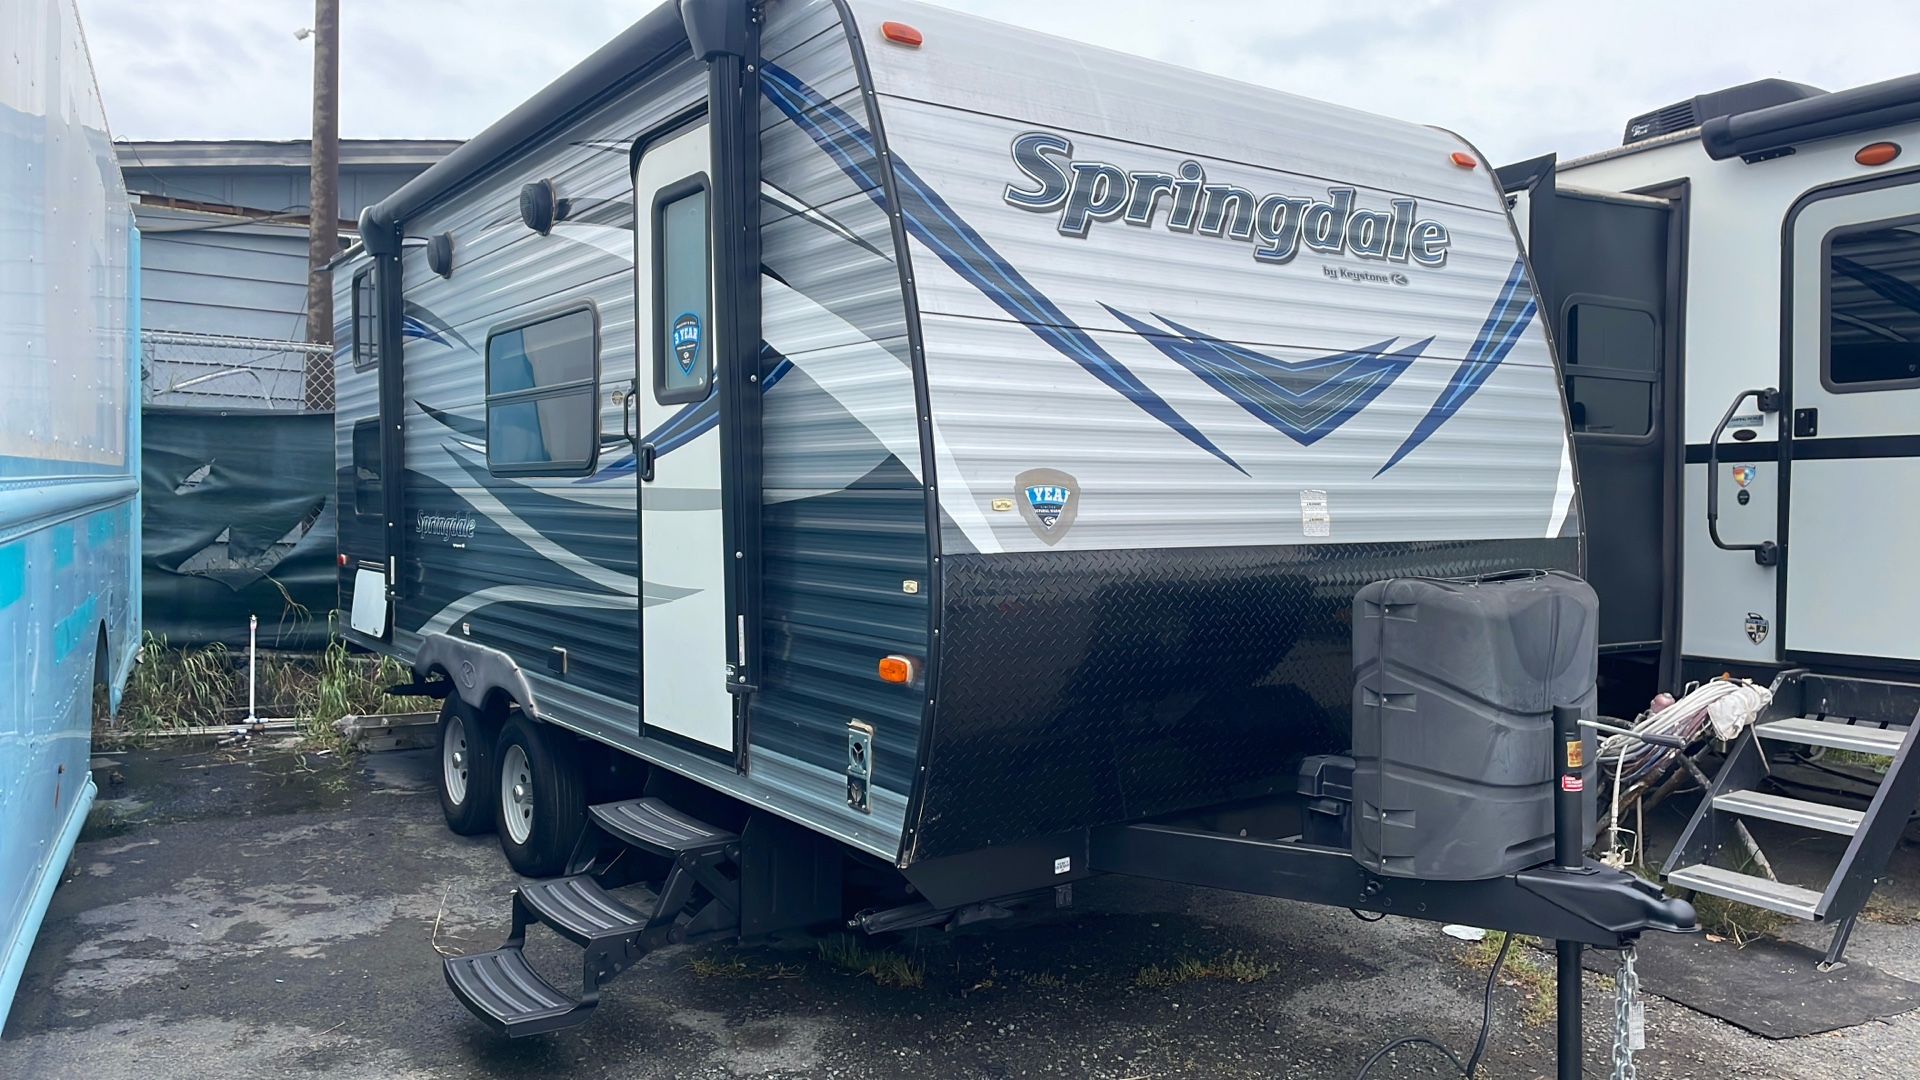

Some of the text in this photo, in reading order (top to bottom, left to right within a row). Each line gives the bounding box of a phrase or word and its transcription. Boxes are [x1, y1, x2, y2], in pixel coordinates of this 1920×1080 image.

[1003, 130, 1452, 268] Springdale
[1322, 265, 1389, 283] by Keystone
[416, 509, 476, 542] Springdale
